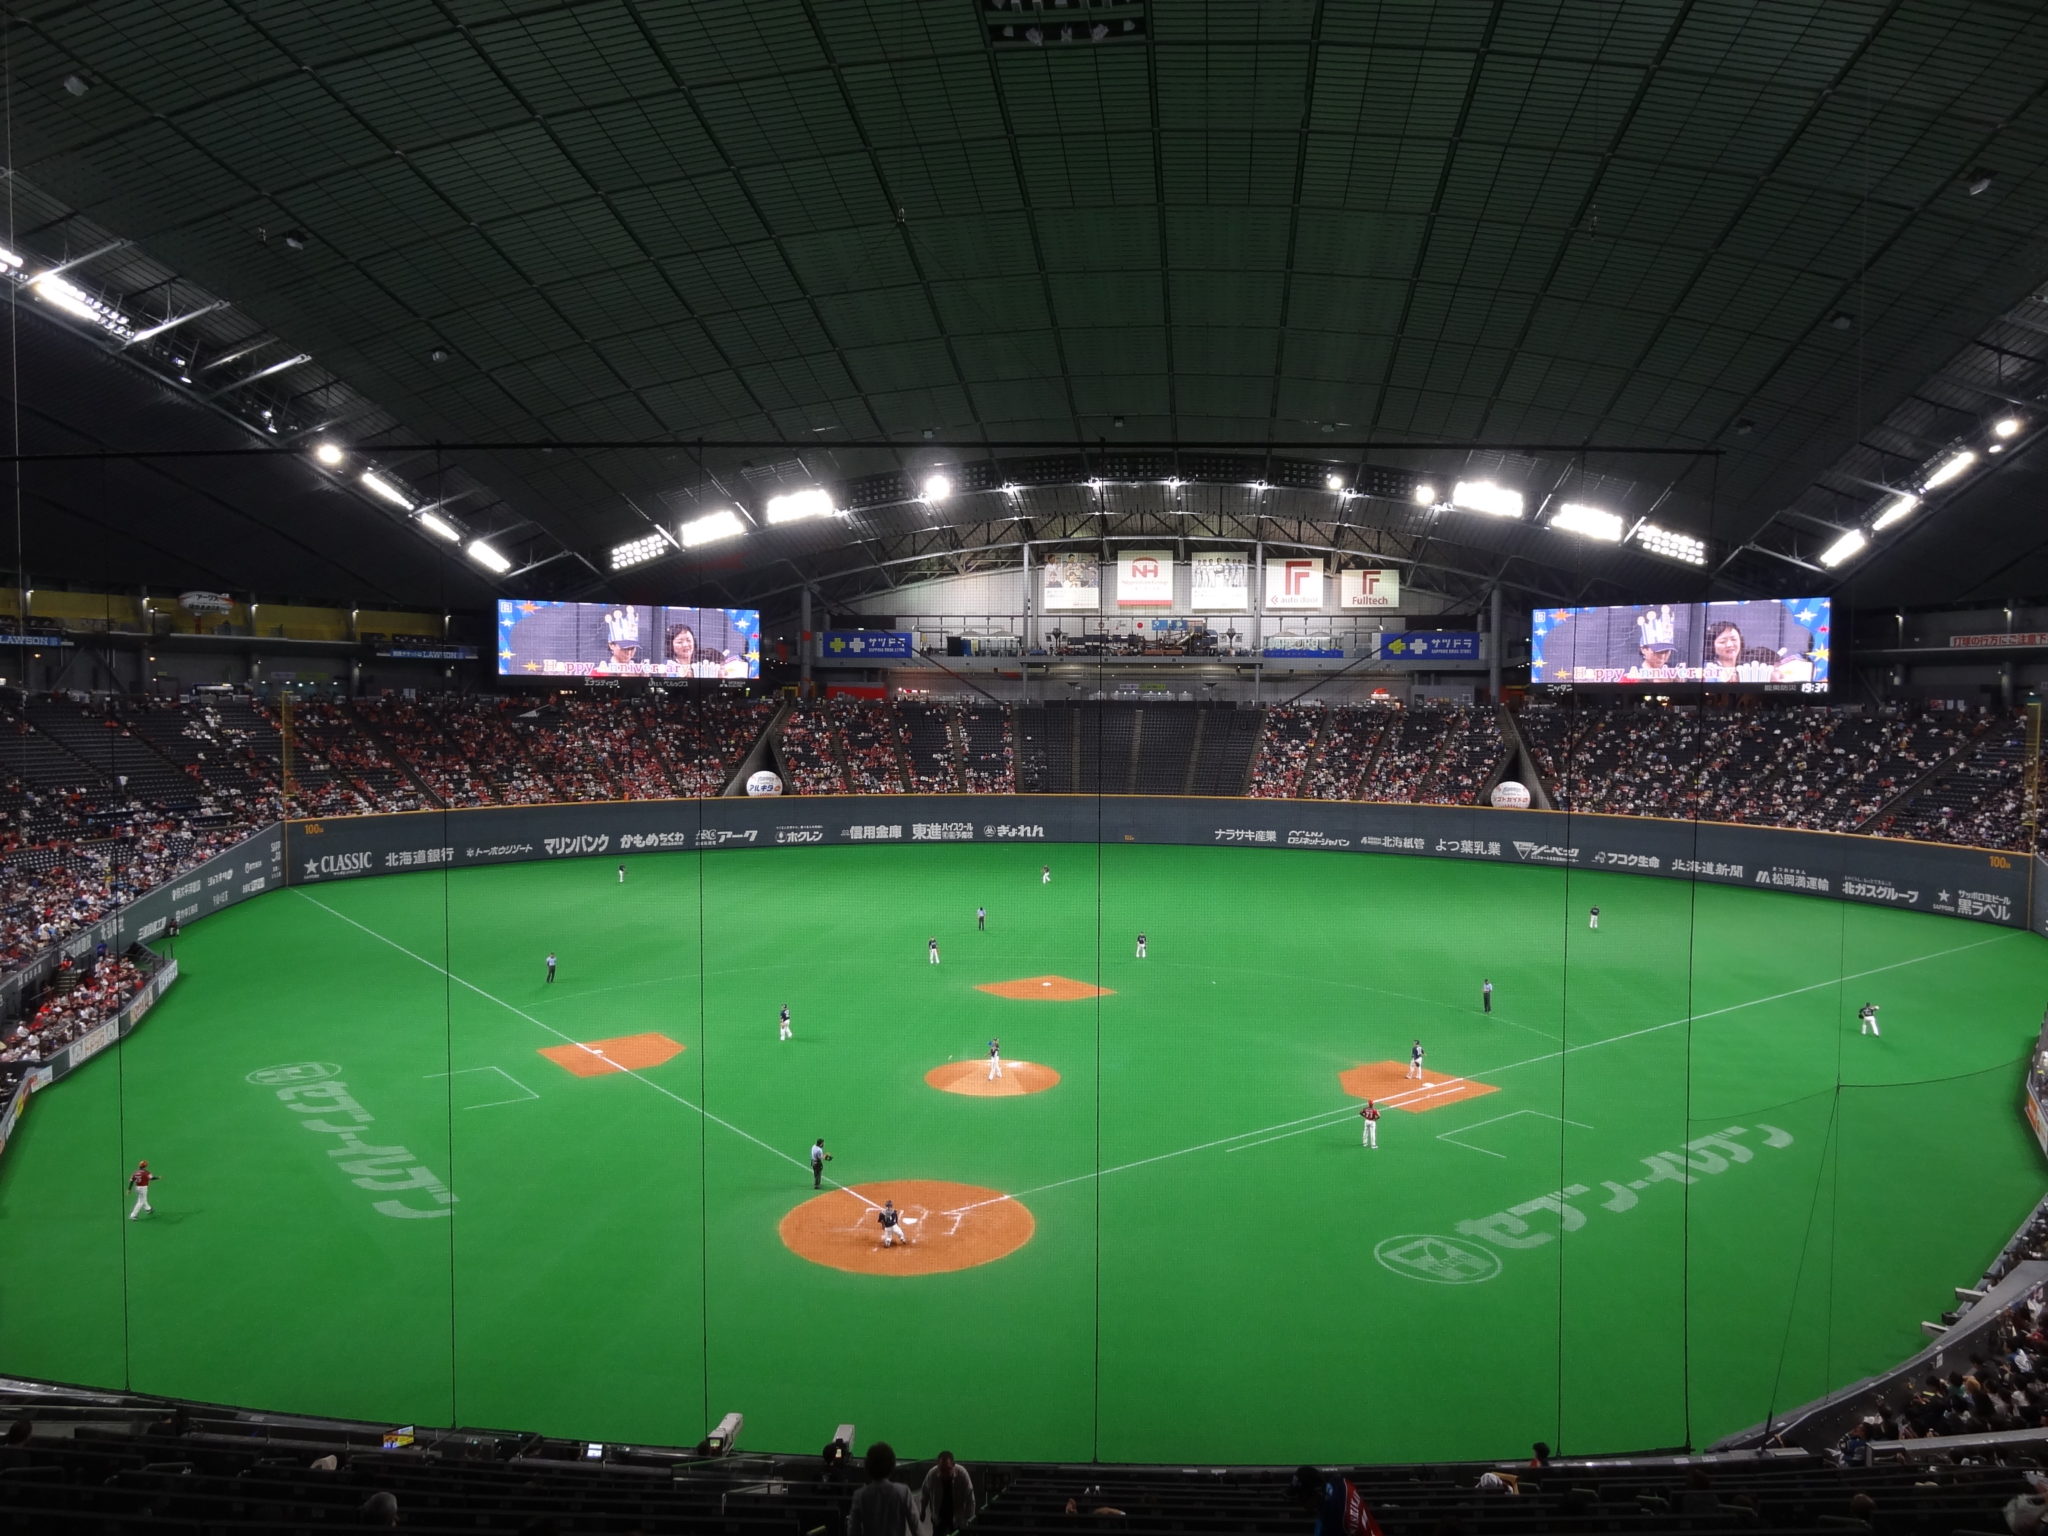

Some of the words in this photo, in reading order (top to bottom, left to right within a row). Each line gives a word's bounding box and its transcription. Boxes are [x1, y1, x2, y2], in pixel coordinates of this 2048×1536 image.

[1132, 564, 1159, 578] NH
[1352, 596, 1388, 605] Fulltech
[0, 635, 49, 645] LAWSON
[869, 638, 906, 647] サツドラ
[1431, 639, 1472, 648] サツドラ
[543, 659, 594, 675] Happy
[1574, 666, 1625, 681] Happy
[1801, 683, 1828, 693] 19:37
[717, 830, 758, 843] アーク
[787, 831, 823, 842] ホクレン
[850, 824, 902, 839] 信用金庫
[912, 823, 941, 840] 東進
[942, 822, 974, 831] ハイスクール
[997, 824, 1045, 838] ぎょれん
[1214, 828, 1277, 842] ナラサキ産業
[544, 833, 609, 855] マリンバンク
[620, 831, 685, 848] かもめちくわ
[1287, 836, 1350, 847] ロジネットジャパン
[1381, 836, 1425, 849] 北海紙管
[1435, 838, 1501, 856] よつ葉乳業
[321, 851, 373, 873] CLASSIC
[385, 847, 455, 867] 北海道銀行
[1607, 852, 1661, 868] フコク生命
[1671, 859, 1743, 878] 北海道新聞
[1772, 872, 1830, 892] 松岡満運輸
[1841, 881, 1920, 903] 北ガスグループ
[1957, 898, 2012, 920] 黒ラベル
